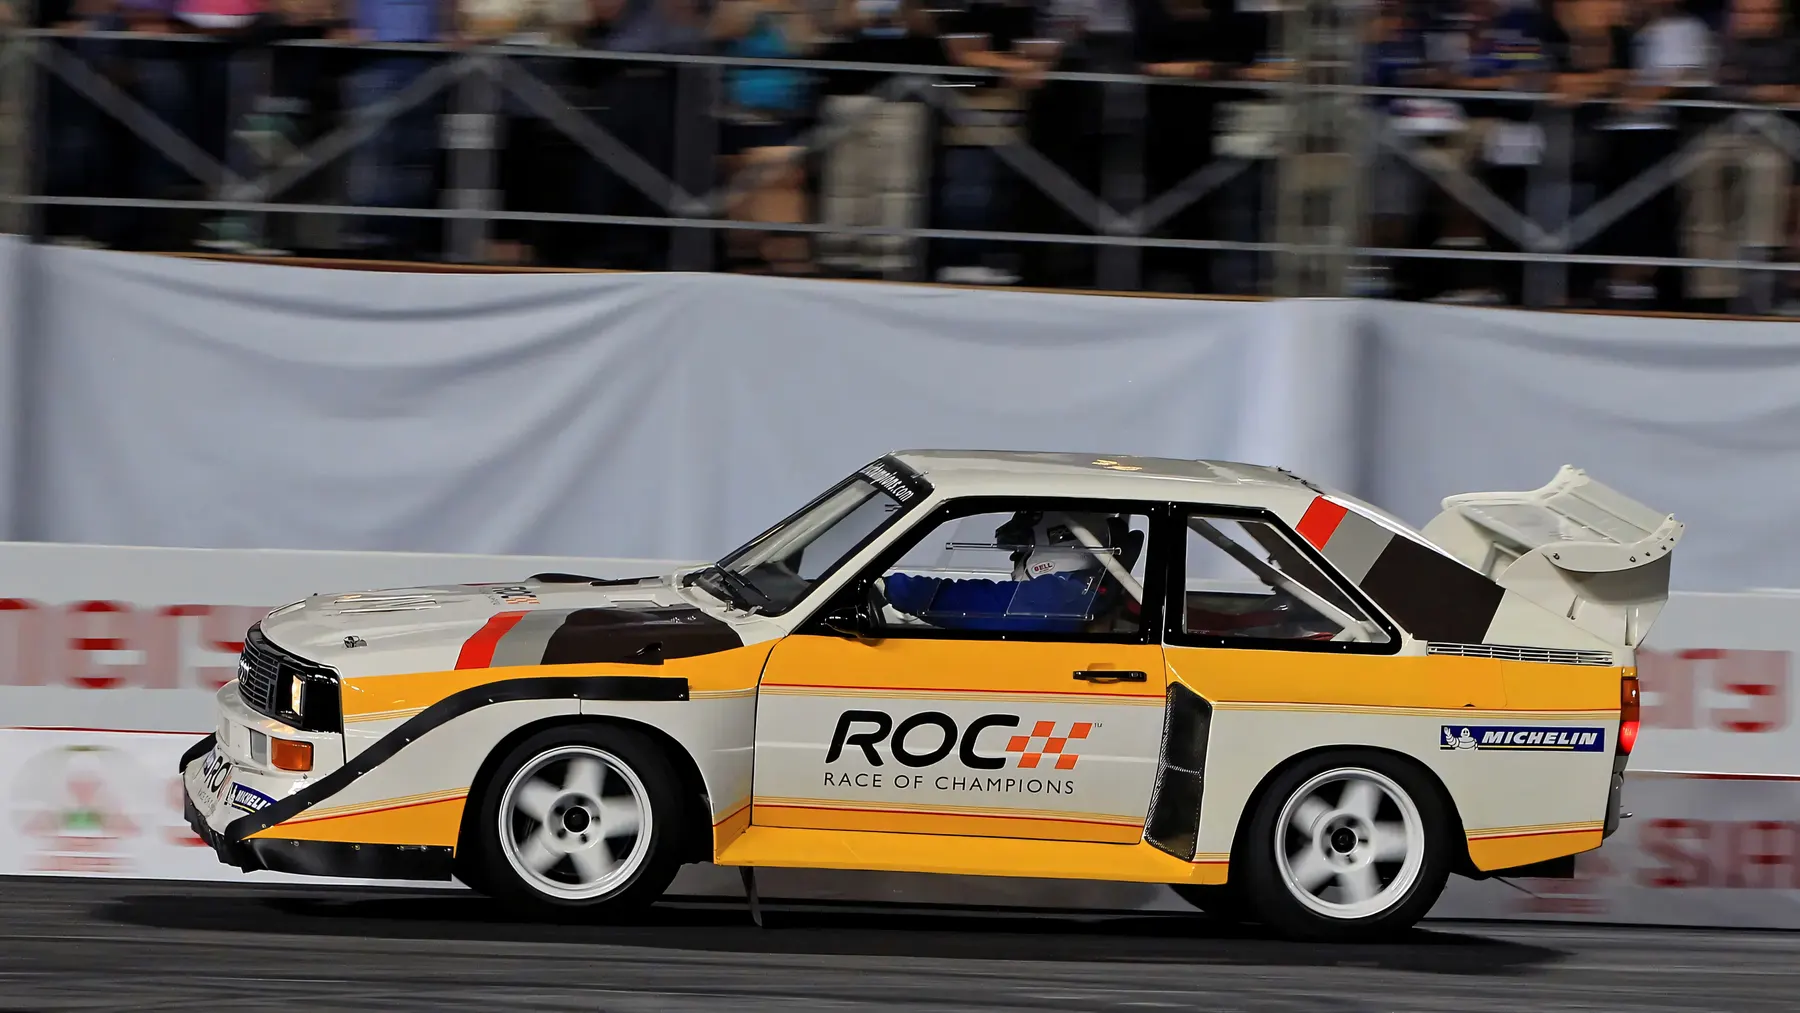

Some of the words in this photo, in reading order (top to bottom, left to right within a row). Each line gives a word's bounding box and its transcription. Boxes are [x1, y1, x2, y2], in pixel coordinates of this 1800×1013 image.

[1034, 562, 1053, 572] BELL
[825, 709, 1020, 770] ROC
[1481, 731, 1598, 745] MICHELIN
[824, 772, 882, 788] RACE
[894, 775, 923, 789] OF
[935, 776, 1075, 795] CHAMPIONS
